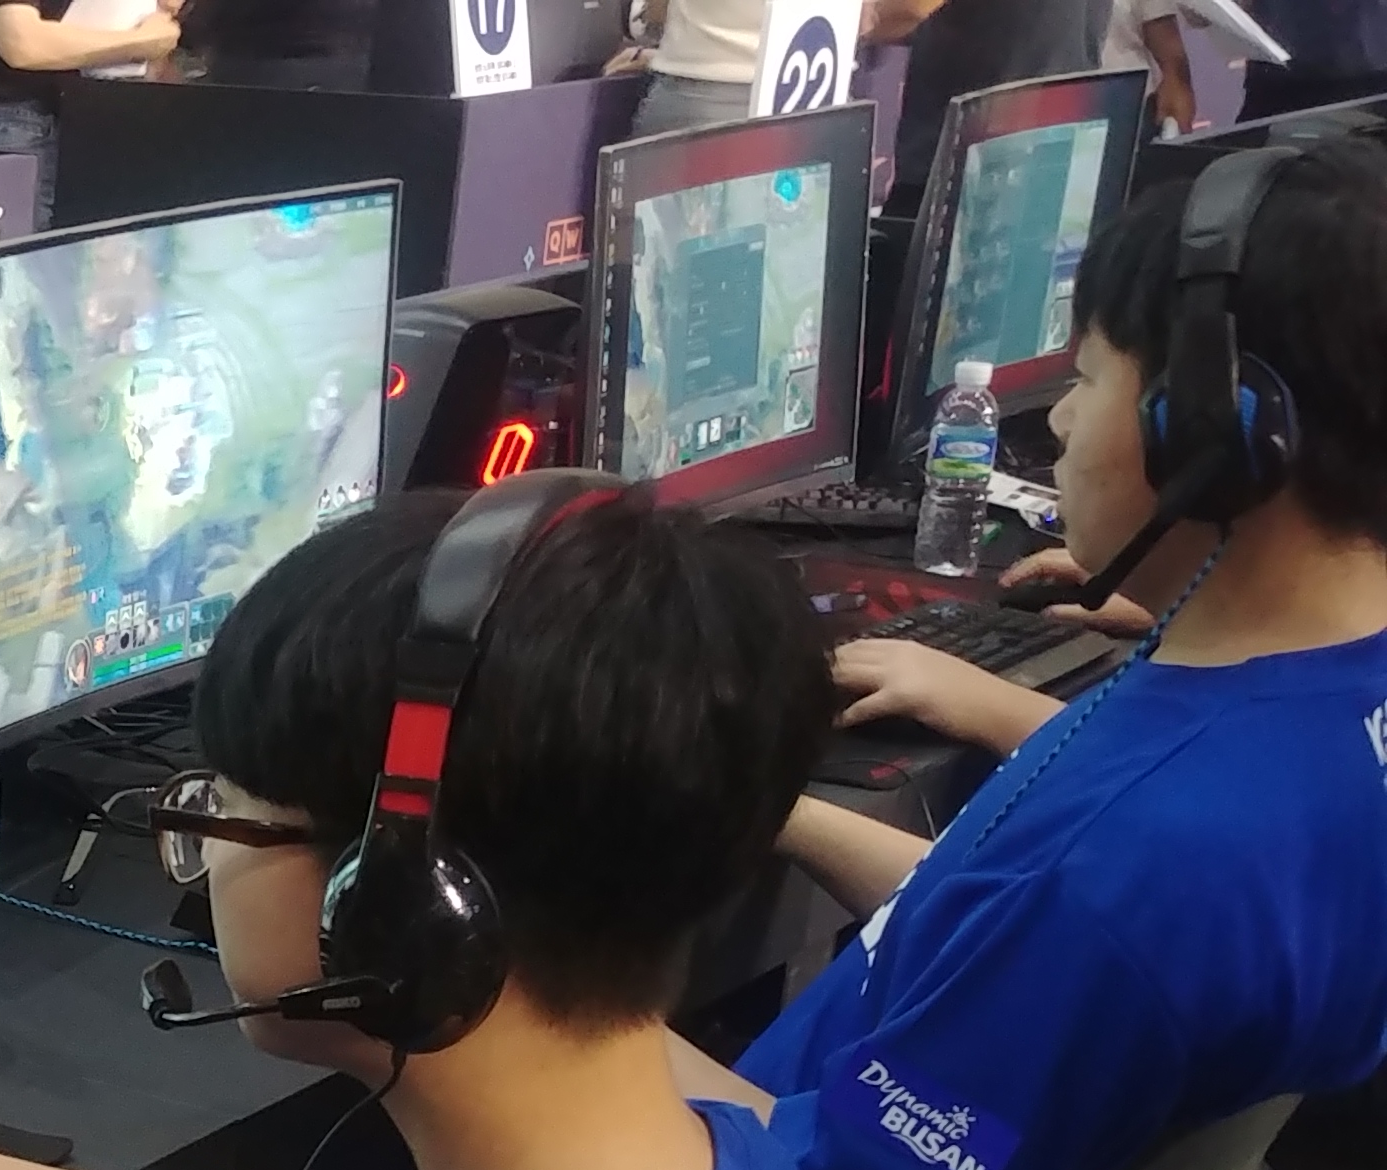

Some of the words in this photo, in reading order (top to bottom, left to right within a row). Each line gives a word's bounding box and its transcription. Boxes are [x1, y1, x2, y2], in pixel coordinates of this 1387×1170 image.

[781, 47, 835, 114] 22
[550, 228, 563, 252] Q
[857, 1059, 970, 1141] Dynamic
